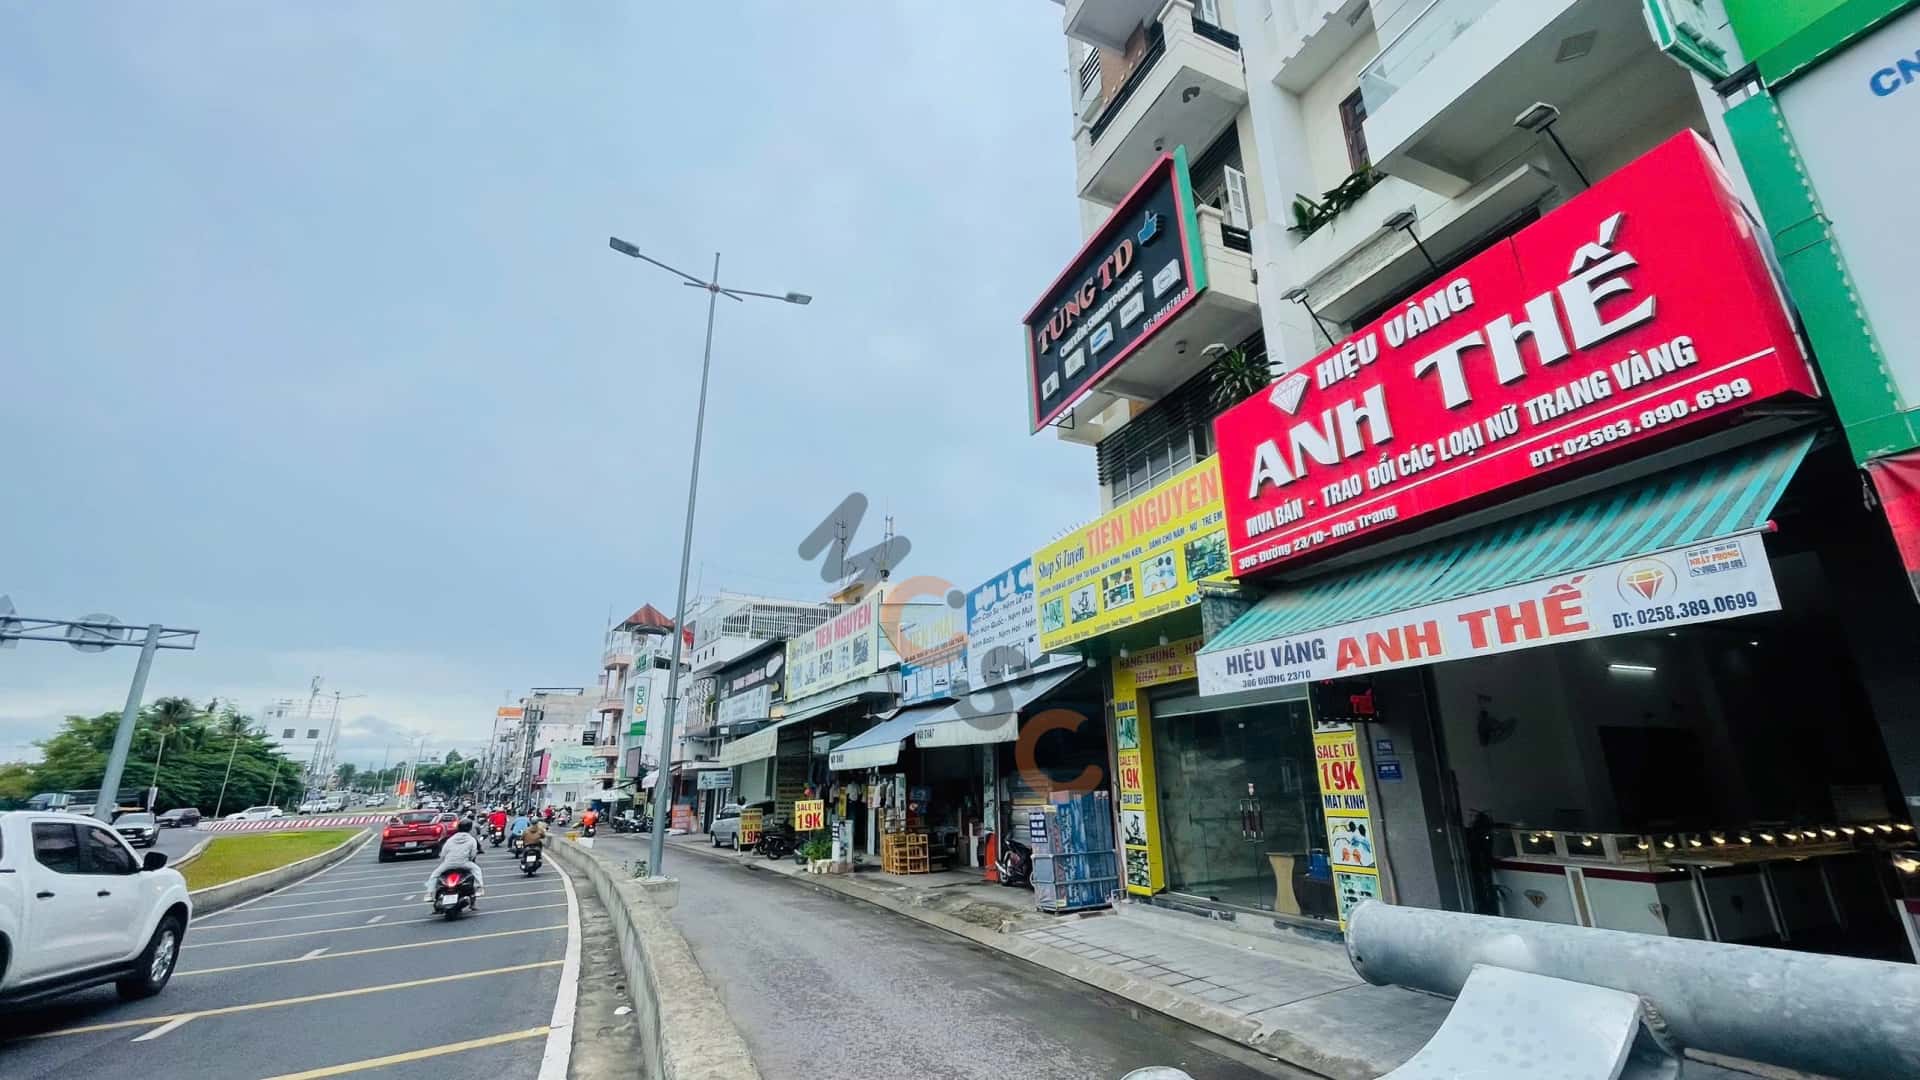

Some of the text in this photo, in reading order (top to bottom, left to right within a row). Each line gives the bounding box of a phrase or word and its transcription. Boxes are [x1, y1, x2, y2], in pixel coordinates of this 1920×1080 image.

[1038, 238, 1133, 354] TÙNG TD
[1088, 270, 1143, 331] SMARTPHONE
[1316, 278, 1475, 389] HIỆU VÀNG
[1249, 212, 1656, 499] ANH THẾ
[1246, 511, 1275, 537] MUA
[1275, 498, 1304, 526] BÁN
[1321, 473, 1363, 507] TRAO
[1367, 451, 1398, 490] ĐỔI
[1398, 443, 1436, 476] CÁC
[1438, 421, 1485, 461] LOẠI
[1524, 370, 1613, 425] TRANG
[1611, 335, 1698, 390] VÀNG
[1086, 513, 1125, 559] TIEN
[1130, 467, 1219, 537] NGUYEN
[1357, 505, 1397, 528] Trang
[834, 601, 872, 641] NGUYEN
[1226, 574, 1590, 677] HIỆU VÀNG ANH THẾ
[1612, 591, 1758, 629] ĐT: 0258.389.0699
[1287, 669, 1312, 682] 23/10
[1119, 756, 1131, 767] SALE
[1317, 743, 1340, 759] SALE
[1121, 768, 1141, 790] 19K
[1320, 761, 1361, 790] 19K
[796, 803, 811, 811] SALE
[798, 812, 822, 829] 19K
